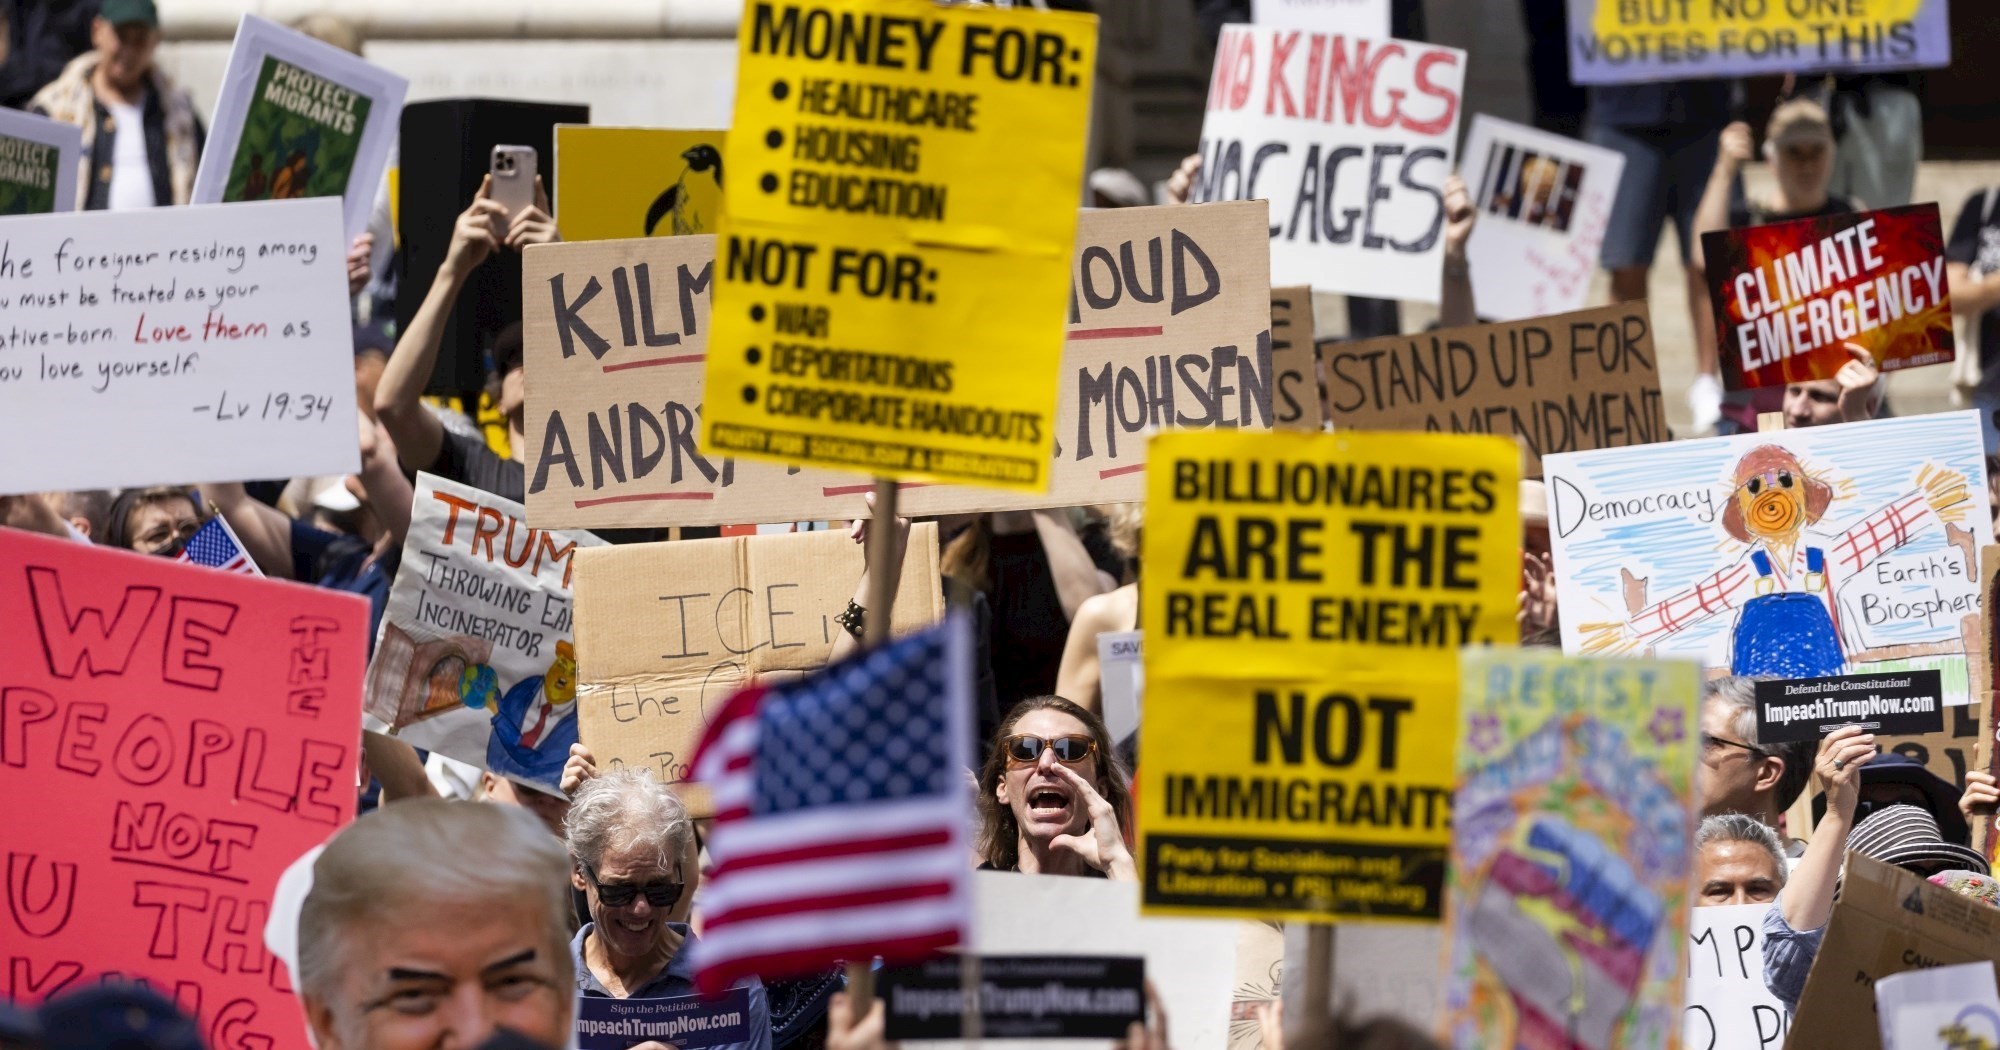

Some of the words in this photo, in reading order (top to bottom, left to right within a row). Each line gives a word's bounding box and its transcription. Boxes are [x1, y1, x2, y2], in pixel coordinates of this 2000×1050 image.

[1578, 30, 1709, 66] VOTES
[1718, 28, 1799, 60] FOR
[1808, 20, 1919, 64] THIS
[1618, 0, 1692, 26] BUT
[752, 2, 946, 73] MONEY
[959, 24, 1084, 89] FOR:
[264, 80, 358, 136] MIGRANTS
[273, 61, 358, 113] PROTECT
[798, 77, 979, 133] HEALTHCARE
[1207, 31, 1256, 112] NO
[1264, 31, 1460, 137] KINGS
[793, 125, 921, 174] HOUSING
[788, 169, 948, 222] EDUCATION
[1246, 142, 1448, 255] CAGES
[54, 237, 160, 280] foreigner
[169, 240, 246, 274] residing
[258, 242, 318, 266] among
[726, 236, 817, 291] NOT
[829, 247, 939, 305] FOR:
[1734, 217, 1884, 322] CLIMATE
[19, 290, 69, 309] must
[79, 284, 99, 307] be
[112, 276, 176, 304] treated
[185, 287, 206, 301] as
[208, 284, 260, 311] your
[547, 261, 717, 361] KILM
[1069, 228, 1221, 325] OUD
[774, 302, 831, 339] WAR
[1736, 255, 1945, 373] EMERGENCY
[134, 312, 192, 344] Love
[202, 309, 267, 343] them
[282, 320, 311, 338] as
[40, 352, 83, 381] love
[770, 340, 955, 394] DEPORTATIONS
[1332, 336, 1479, 413] STAND
[1489, 326, 1553, 389] UP
[1569, 314, 1654, 382] FOR
[261, 392, 333, 423] 19:34
[528, 400, 735, 494] ANDR
[1075, 329, 1274, 462] MOHSEN
[764, 382, 910, 432] CORPORATE
[911, 402, 1044, 446] HANDOUTS
[1172, 459, 1497, 515] BILLIONAIRES
[1552, 475, 1716, 539] Democracy
[432, 490, 578, 590] TRUM
[1181, 514, 1325, 584] ARE
[1349, 518, 1481, 592] THE
[1876, 555, 1961, 585] Earth's
[420, 550, 532, 615] THROWING
[26, 565, 240, 692] WE
[286, 614, 341, 719] THE
[415, 589, 544, 658] INCINERATOR
[658, 583, 806, 659] ICE
[1164, 591, 1290, 641] REAL
[1307, 595, 1494, 649] ENEMY.
[611, 683, 681, 723] the
[1764, 695, 1936, 727] ImpeachTrumpNow.com
[1785, 684, 1821, 696] Defend
[1823, 682, 1840, 693] the
[1840, 677, 1912, 692] Constitution!
[1, 686, 346, 828] PEOPLE
[1251, 690, 1416, 772] NOT
[111, 800, 259, 873] NOT
[7, 851, 78, 939] U
[133, 880, 297, 995] TH
[610, 1003, 635, 1015] Sign
[636, 1002, 654, 1014] the
[655, 1001, 700, 1014] Petition:
